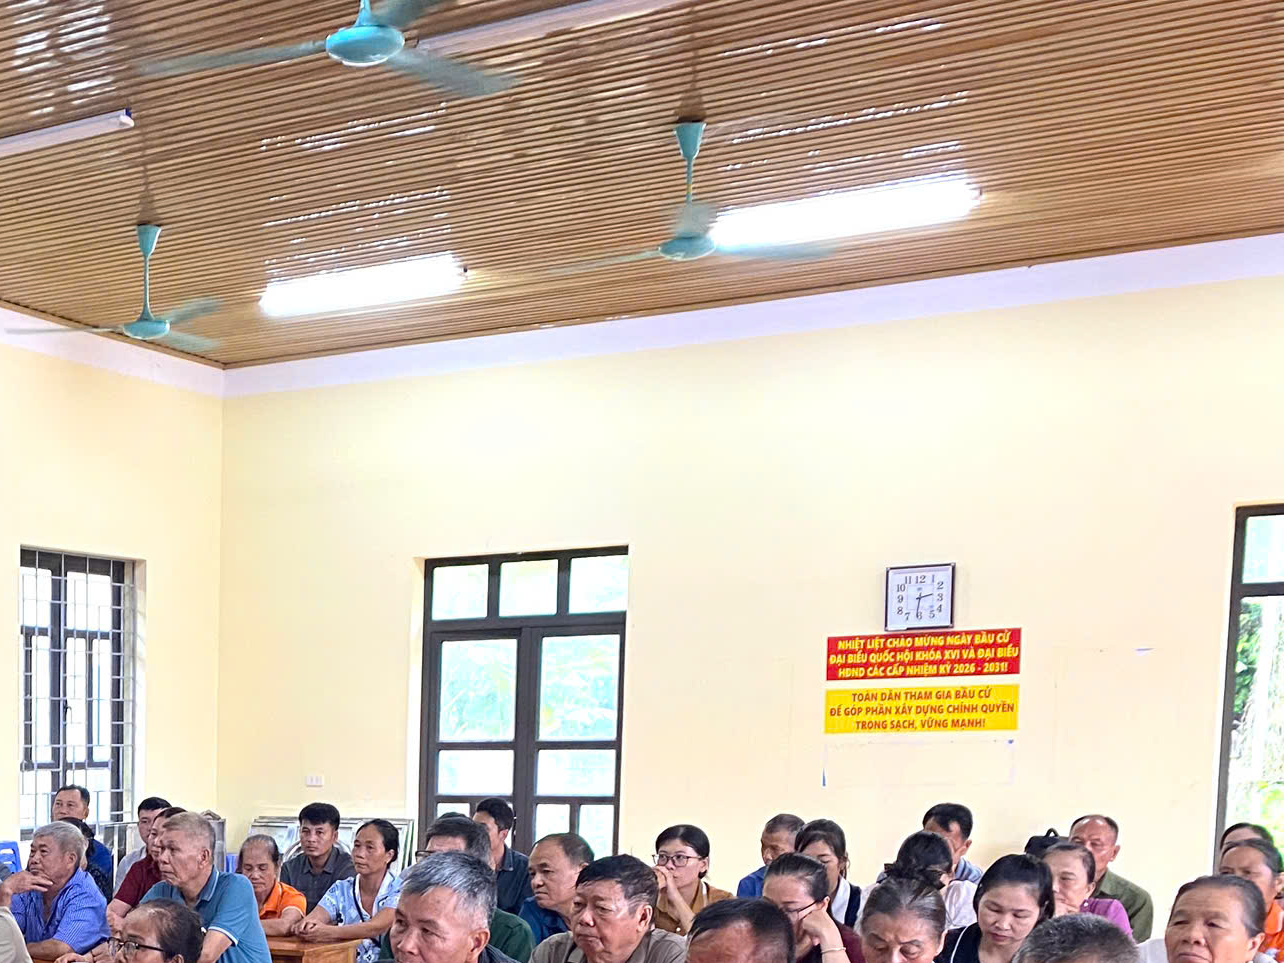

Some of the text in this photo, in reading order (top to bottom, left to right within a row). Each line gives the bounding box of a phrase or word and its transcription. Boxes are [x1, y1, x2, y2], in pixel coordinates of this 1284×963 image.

[852, 685, 992, 702] TOÀN DÂN THAM GIA BẦU CỬ
[829, 701, 1015, 716] ĐỂ GÓP PHẦN XÂY DỰNG CHÍNH QUYỀN
[856, 717, 986, 732] TRONG SẠCH, VỮNG MẠNH!
